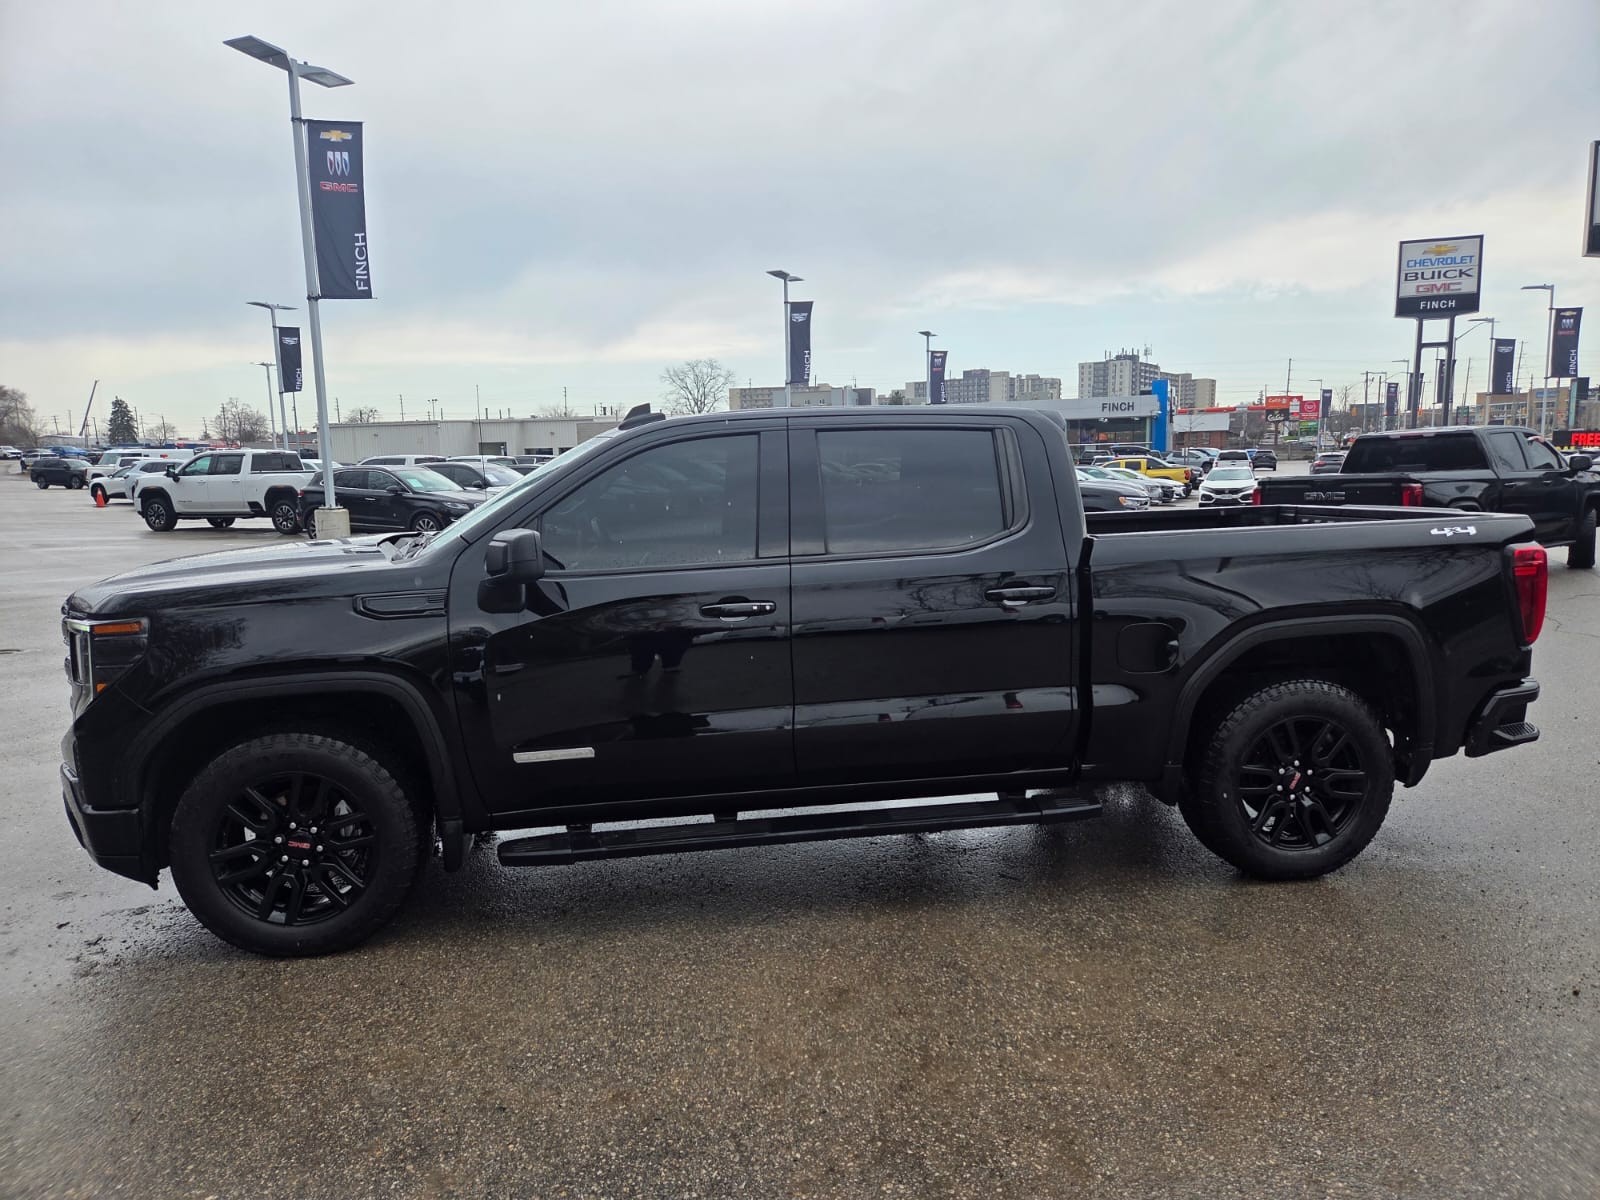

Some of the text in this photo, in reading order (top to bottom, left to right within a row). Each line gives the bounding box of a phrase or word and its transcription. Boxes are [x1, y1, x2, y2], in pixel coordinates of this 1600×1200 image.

[320, 181, 358, 192] GMC
[354, 233, 369, 291] FINCH
[1406, 255, 1475, 268] CHEVROLET
[1403, 267, 1474, 282] BUICK
[1415, 282, 1462, 294] GMC
[1420, 299, 1456, 309] FINCH
[803, 350, 811, 380] FINCH
[1569, 349, 1577, 375] FINCH
[295, 367, 303, 390] FINCH
[1101, 401, 1135, 412] FINCH
[1303, 491, 1346, 501] GMC
[287, 840, 311, 849] GMC
